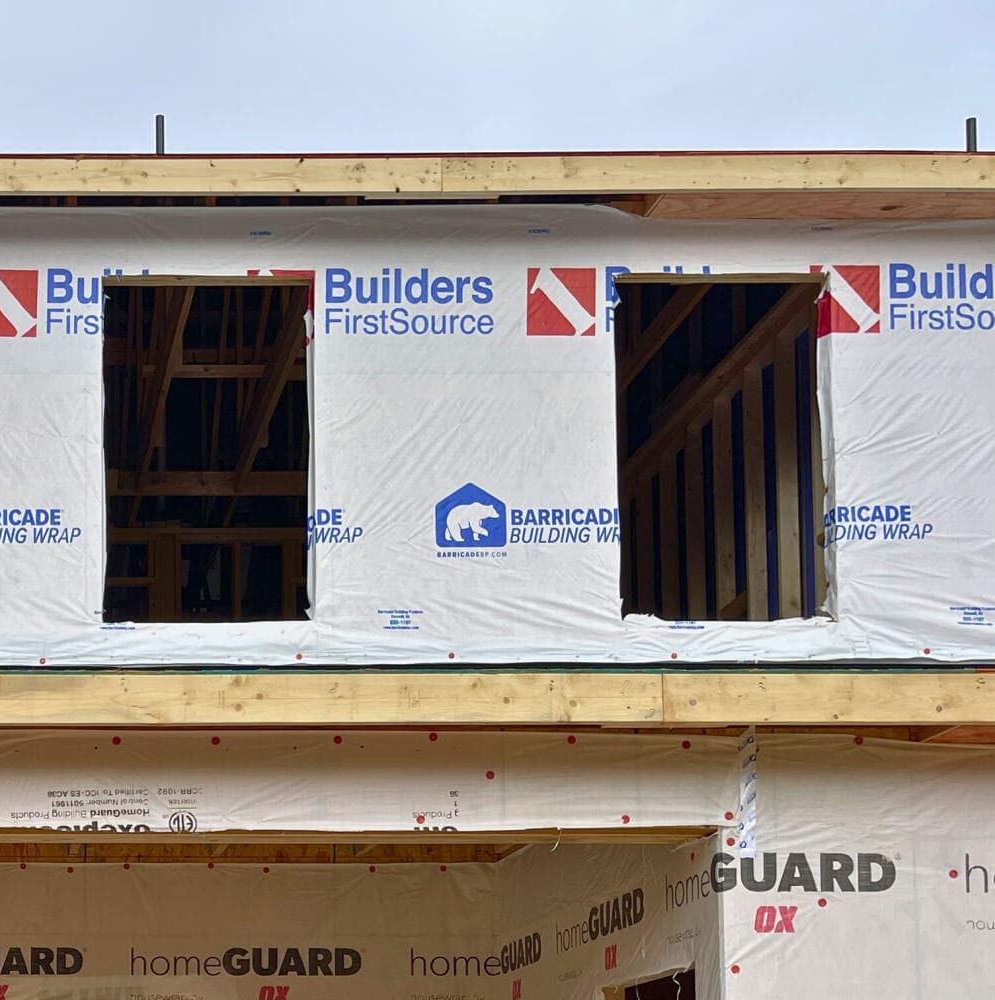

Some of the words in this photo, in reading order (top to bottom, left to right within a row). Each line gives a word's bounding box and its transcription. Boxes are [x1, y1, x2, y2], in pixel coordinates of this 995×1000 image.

[325, 268, 494, 304] Builders
[46, 308, 103, 335] Firs
[325, 308, 495, 335] FirstSource
[33, 527, 81, 544] WRAP
[510, 527, 591, 544] BUILDING
[884, 523, 933, 540] WRAP
[11, 810, 49, 819] Products
[90, 808, 150, 818] HomeGuard
[665, 852, 896, 912] homeGUARD
[555, 887, 645, 954] homeGUARD
[754, 905, 798, 934] OX
[130, 946, 363, 977] homeGUARD
[410, 931, 542, 977] homeGUARD
